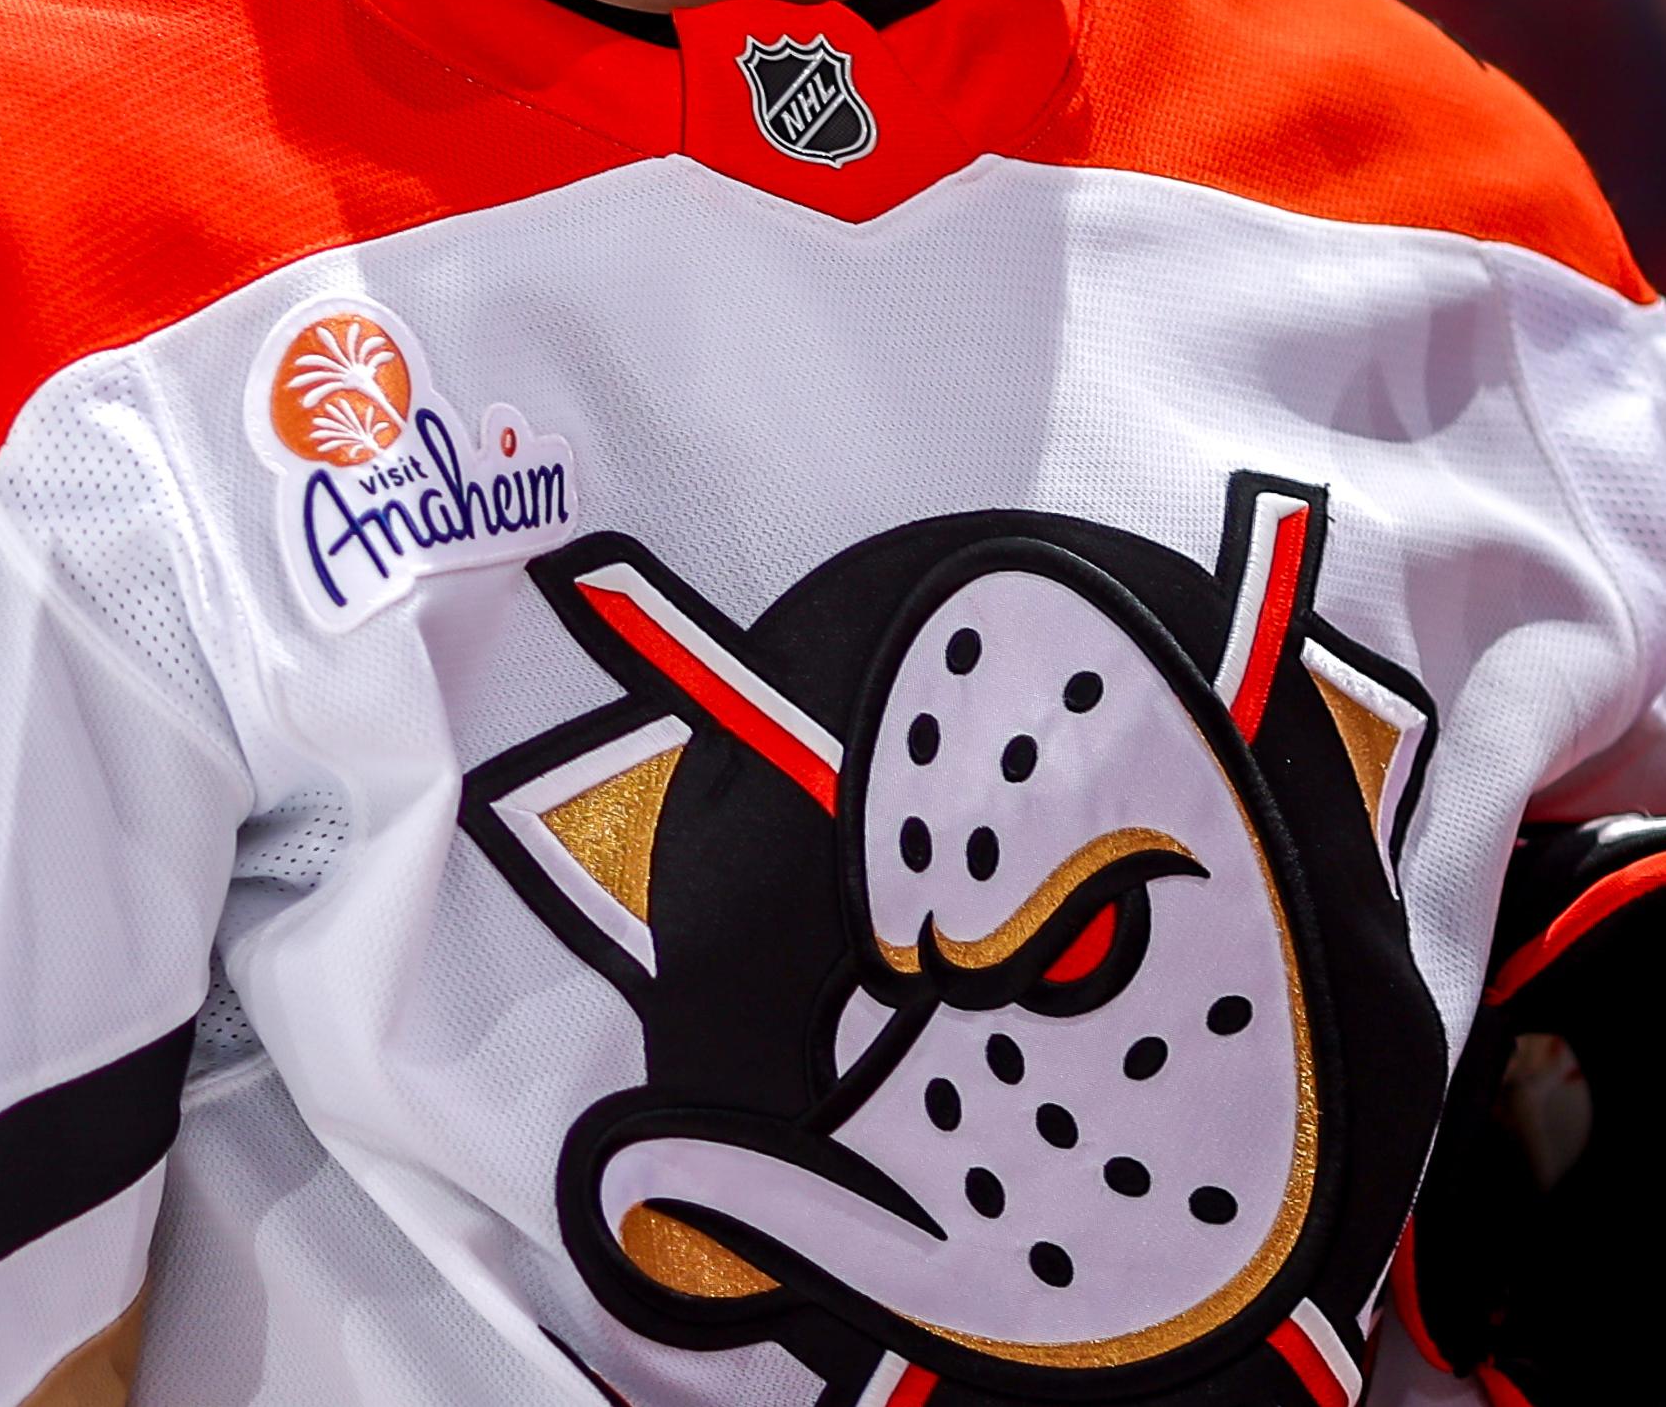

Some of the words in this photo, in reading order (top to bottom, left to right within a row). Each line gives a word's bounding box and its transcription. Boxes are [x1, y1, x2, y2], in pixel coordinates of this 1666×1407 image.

[780, 72, 837, 141] NHL
[303, 408, 569, 607] Anaheim
[359, 455, 428, 495] visit
